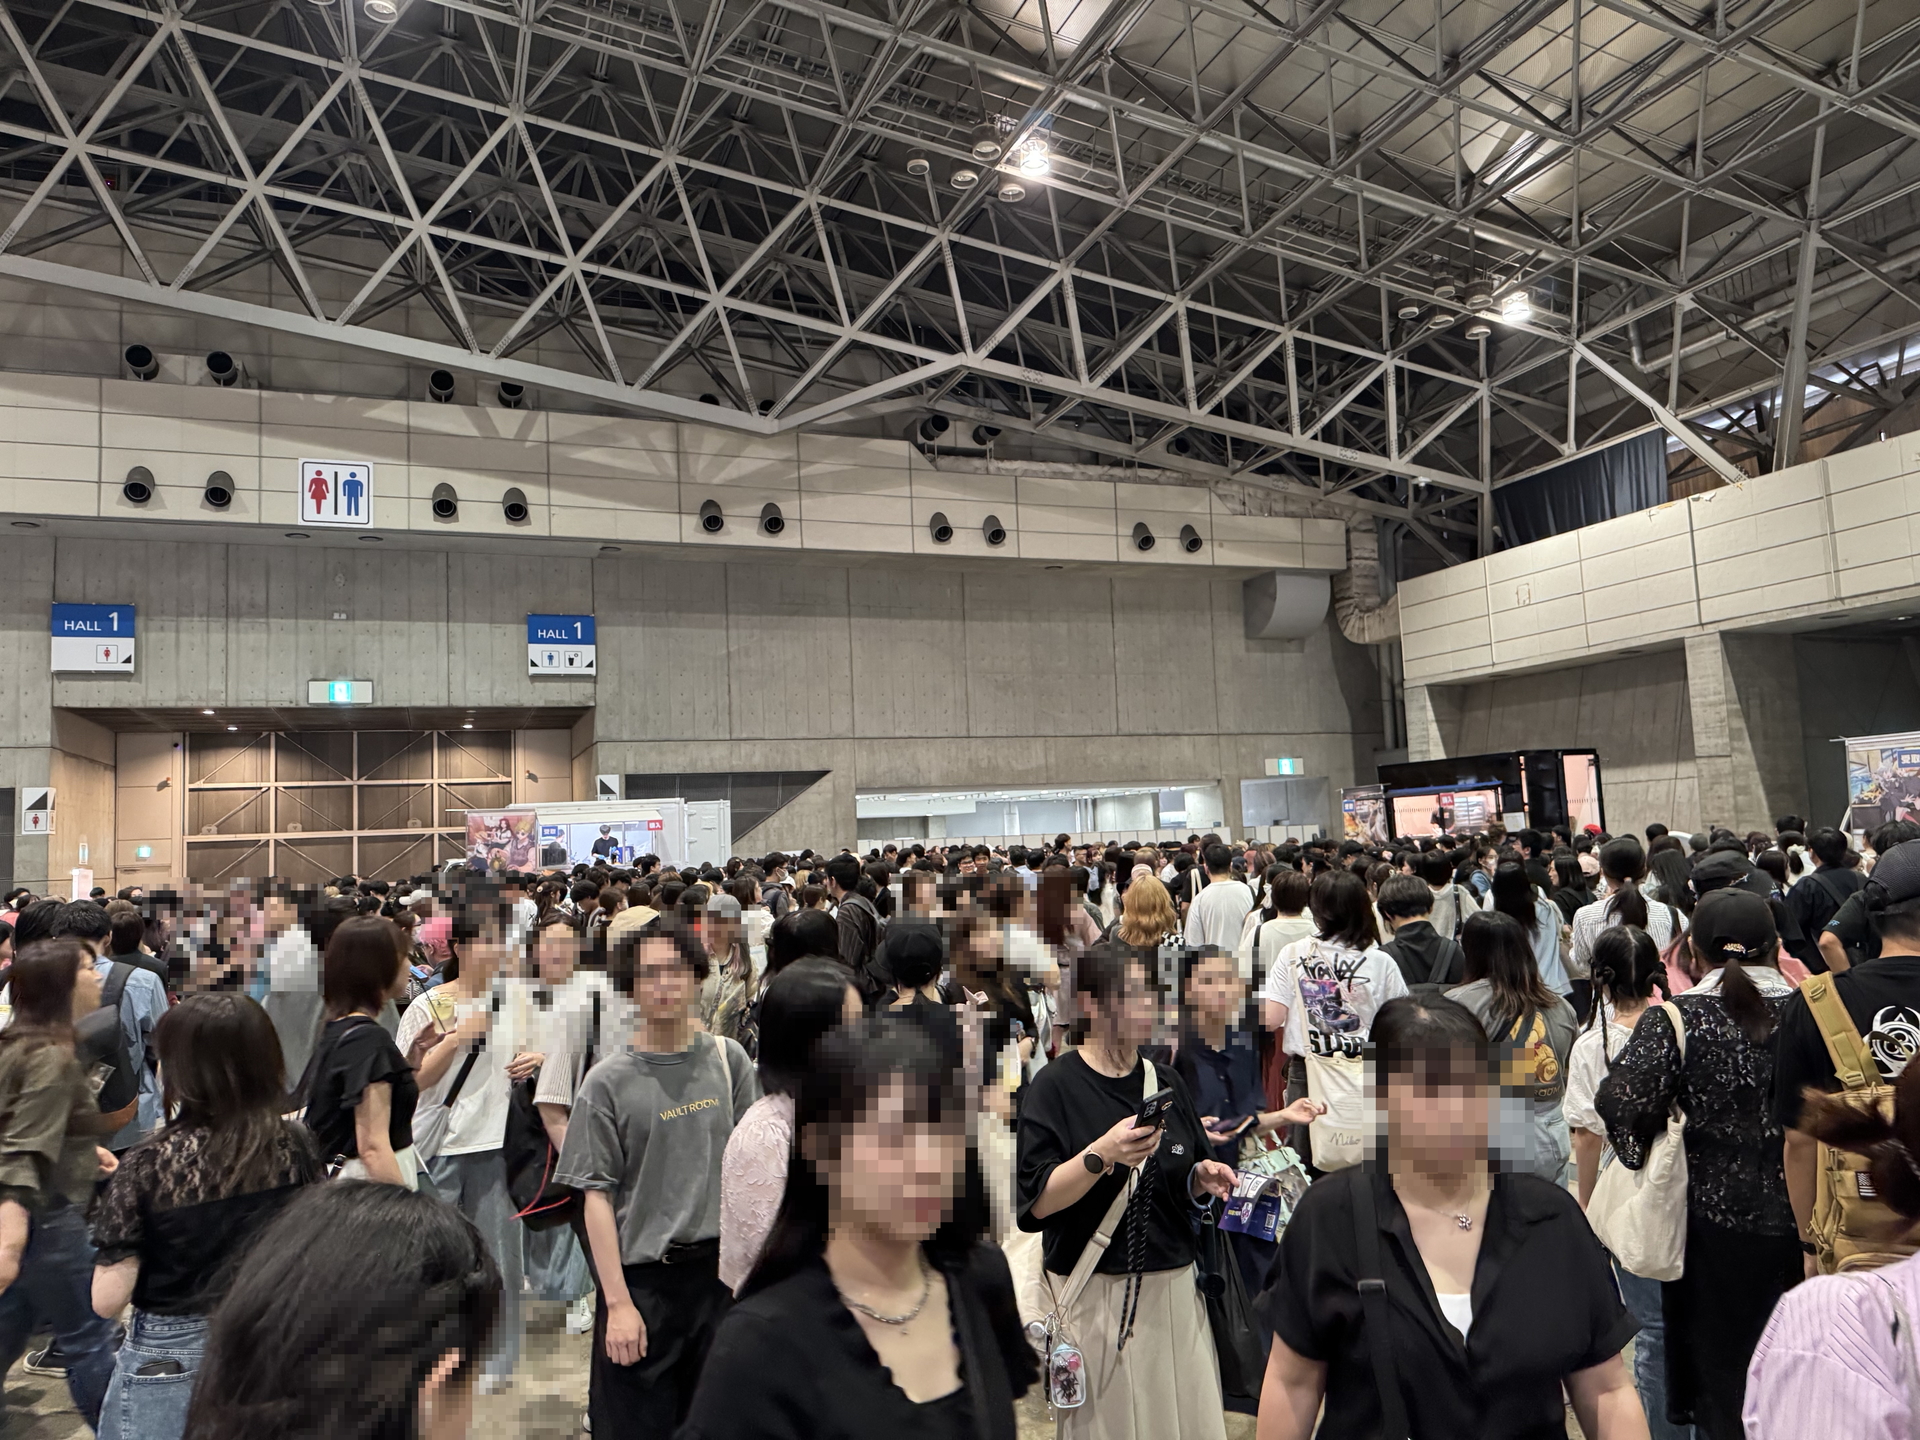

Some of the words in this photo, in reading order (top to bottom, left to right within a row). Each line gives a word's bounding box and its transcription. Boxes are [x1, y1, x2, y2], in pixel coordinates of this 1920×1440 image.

[64, 620, 102, 631] HALL
[108, 611, 119, 632] 1
[537, 629, 569, 639] HALL
[573, 621, 582, 639] 1
